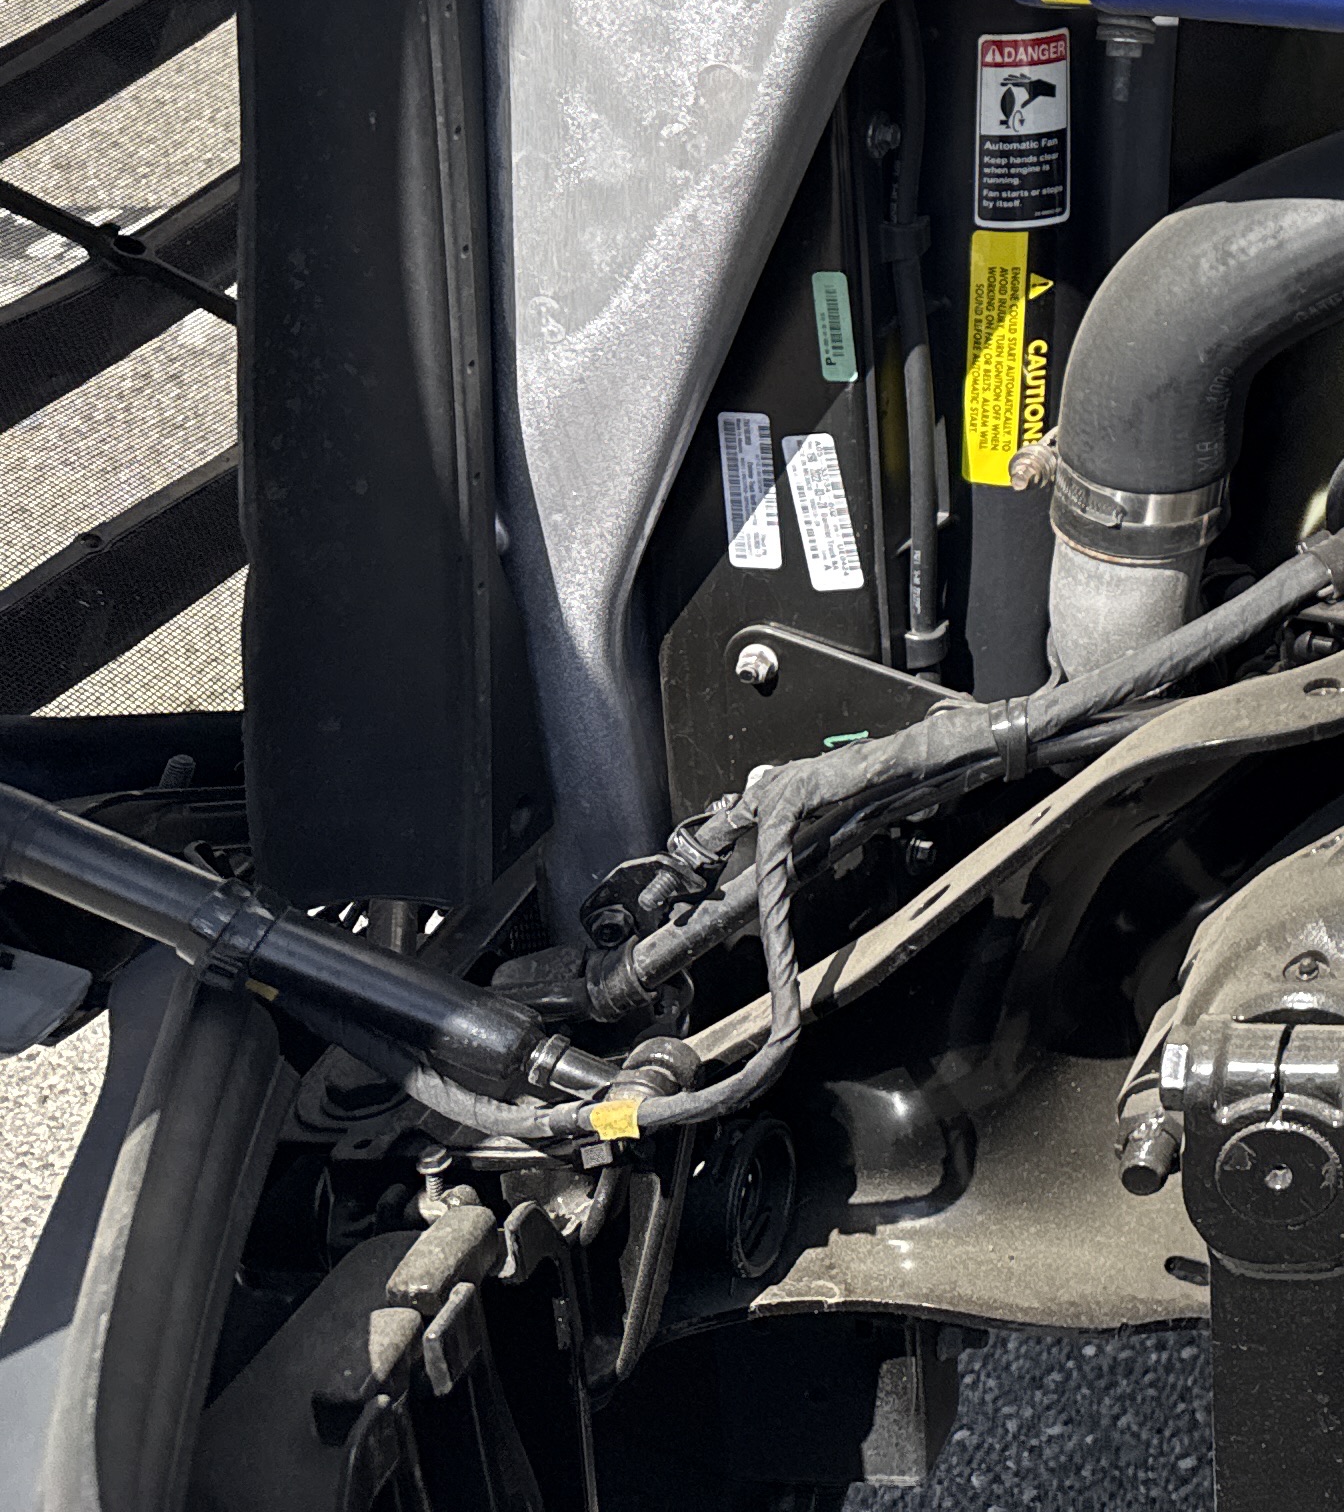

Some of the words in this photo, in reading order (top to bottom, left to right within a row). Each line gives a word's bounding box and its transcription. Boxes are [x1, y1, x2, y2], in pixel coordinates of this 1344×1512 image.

[1003, 41, 1065, 62] DANGER
[984, 140, 1039, 151] Automatic
[1041, 138, 1058, 148] Fan
[983, 156, 1008, 164] Keep
[1009, 153, 1038, 163] hands
[1039, 152, 1059, 162] clear
[1010, 165, 1040, 175] engine
[983, 176, 1022, 185] running.
[983, 188, 1000, 197] Fan
[1002, 188, 1029, 197] starts
[1031, 188, 1041, 196] or
[983, 199, 994, 208] by
[996, 199, 1022, 207] itself.
[986, 266, 997, 312] WORKING
[998, 267, 1008, 295] AVOID
[1009, 267, 1020, 302] ENGINE
[974, 283, 984, 315] SOUND
[985, 314, 995, 330] ON
[1008, 304, 1018, 334] COULD
[972, 318, 982, 350] BEFORE
[984, 332, 993, 349] FAN
[995, 334, 1004, 358] TURN
[1007, 337, 1017, 362] START
[825, 357, 837, 366] P
[983, 353, 993, 365] OR
[970, 353, 981, 404] AUTOMATIC
[992, 361, 1003, 402] IGNITION
[980, 397, 991, 427] ALARM
[992, 404, 1001, 421] OFF
[979, 431, 989, 449] WILL
[991, 424, 1000, 451] WHEN
[1002, 440, 1012, 452] TO
